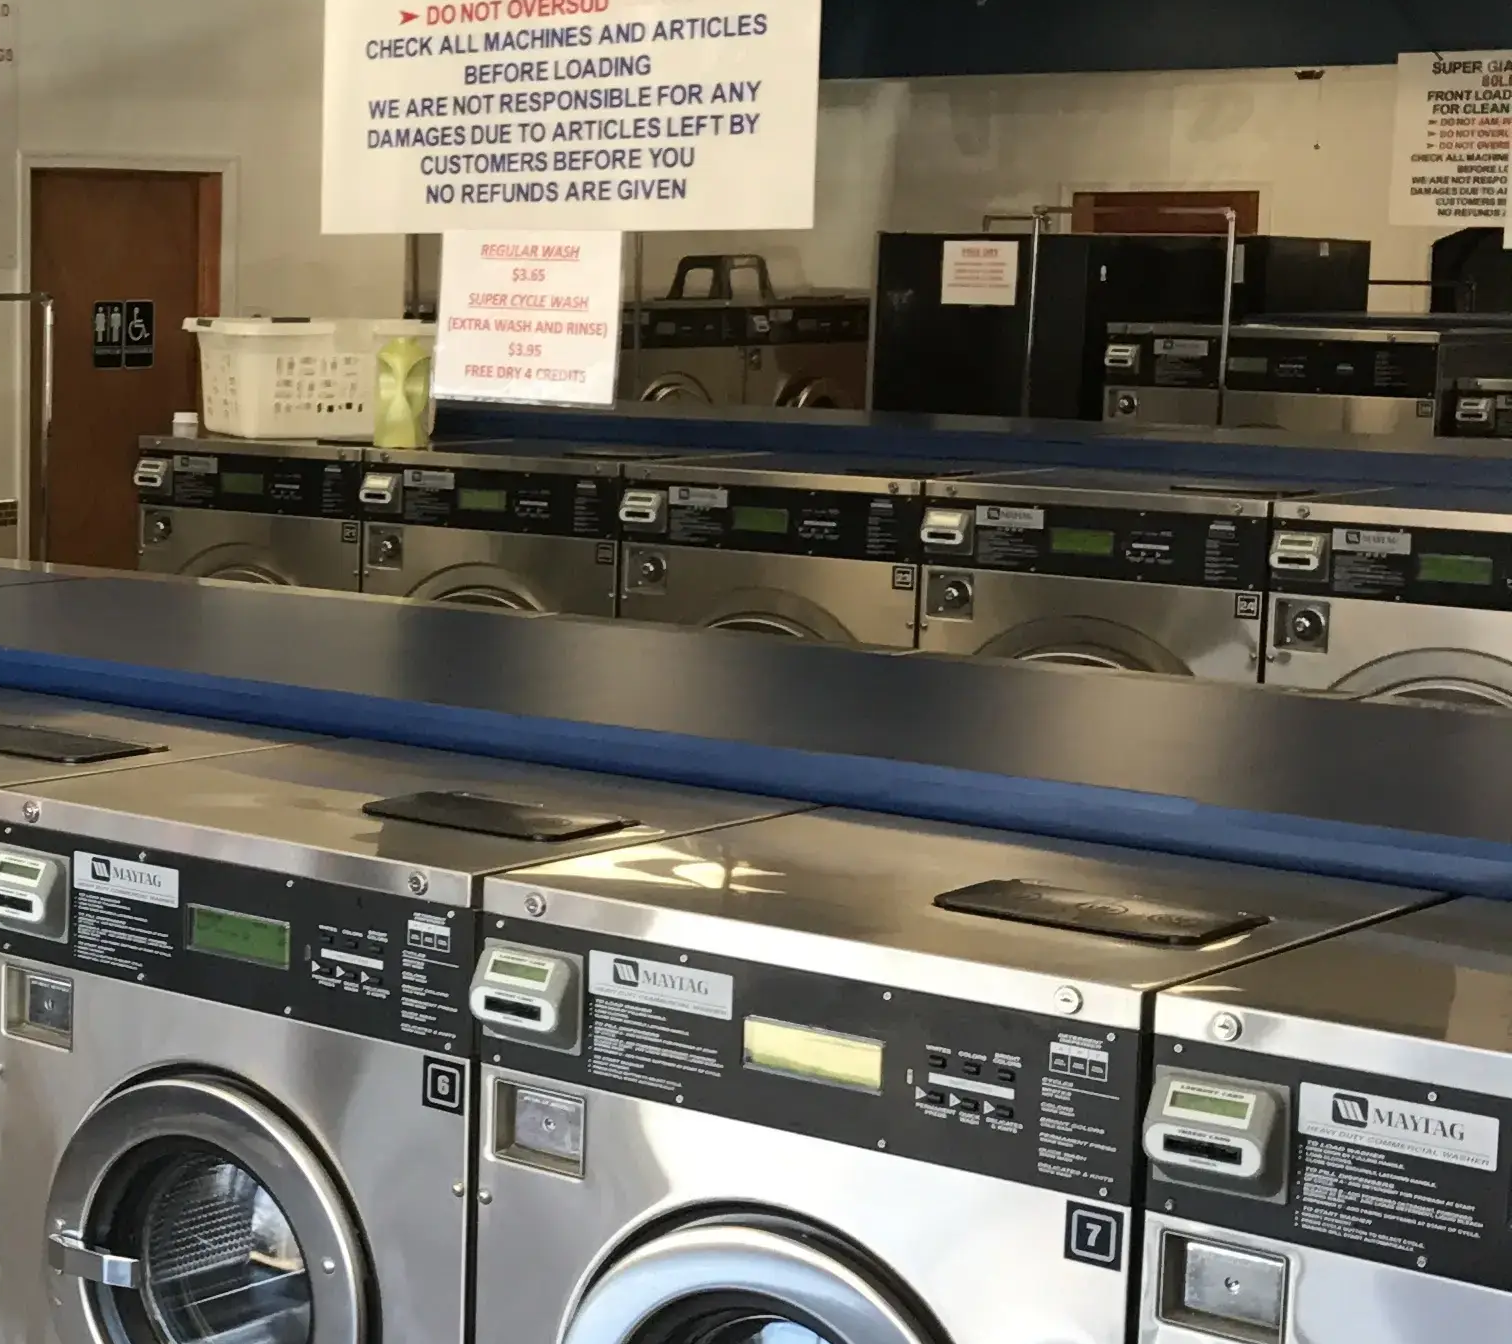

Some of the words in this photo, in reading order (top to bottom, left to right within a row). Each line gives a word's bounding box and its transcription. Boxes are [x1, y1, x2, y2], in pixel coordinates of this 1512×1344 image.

[427, 4, 456, 25] DO
[461, 0, 502, 23] NOT
[366, 36, 432, 59] CHECK
[439, 34, 479, 54] ALL
[484, 25, 592, 52] MACHINES
[599, 22, 645, 45] AND
[652, 14, 767, 41] ARTICLES
[464, 61, 548, 85] BEFORE
[554, 55, 651, 80] LOADING
[1432, 61, 1482, 74] SUPER
[369, 99, 400, 119] WE
[406, 96, 448, 117] ARE
[453, 94, 494, 115] NOT
[500, 86, 651, 113] RESPONSIBLE
[658, 84, 703, 106] FOR
[711, 81, 762, 104] ANY
[1428, 90, 1472, 101] FRONT
[1433, 104, 1460, 114] FOR
[1463, 103, 1510, 114] CLEAN
[368, 125, 466, 148] DAMAGES
[471, 124, 511, 144] DUE
[518, 122, 546, 143] TO
[552, 117, 660, 142] ARTICLES
[667, 115, 723, 137] LEFT
[730, 113, 760, 135] BY
[421, 152, 547, 175] CUSTOMERS
[554, 148, 642, 171] BEFORE
[649, 147, 695, 168] YOU
[426, 184, 454, 204] NO
[461, 182, 558, 203] REFUNDS
[565, 181, 611, 201] ARE
[618, 179, 686, 200] GIVEN
[480, 244, 539, 258] REGULAR
[541, 245, 580, 258] WASH
[512, 268, 545, 282] $3.65
[468, 293, 507, 306] SUPER
[510, 294, 546, 308] CYCLE
[550, 296, 589, 309] WASH
[494, 319, 532, 333] WASH
[535, 321, 563, 334] AND
[508, 342, 542, 357] $3.95
[465, 365, 493, 378] FREE
[496, 366, 521, 379] DRY
[524, 368, 532, 379] 4
[536, 368, 586, 383] CREDITS
[113, 866, 162, 888] MAYTAG
[641, 970, 709, 996] MAYTAG
[437, 1074, 450, 1095] 6
[1372, 1108, 1465, 1141] MAYTAG
[1085, 1222, 1102, 1247] 7
